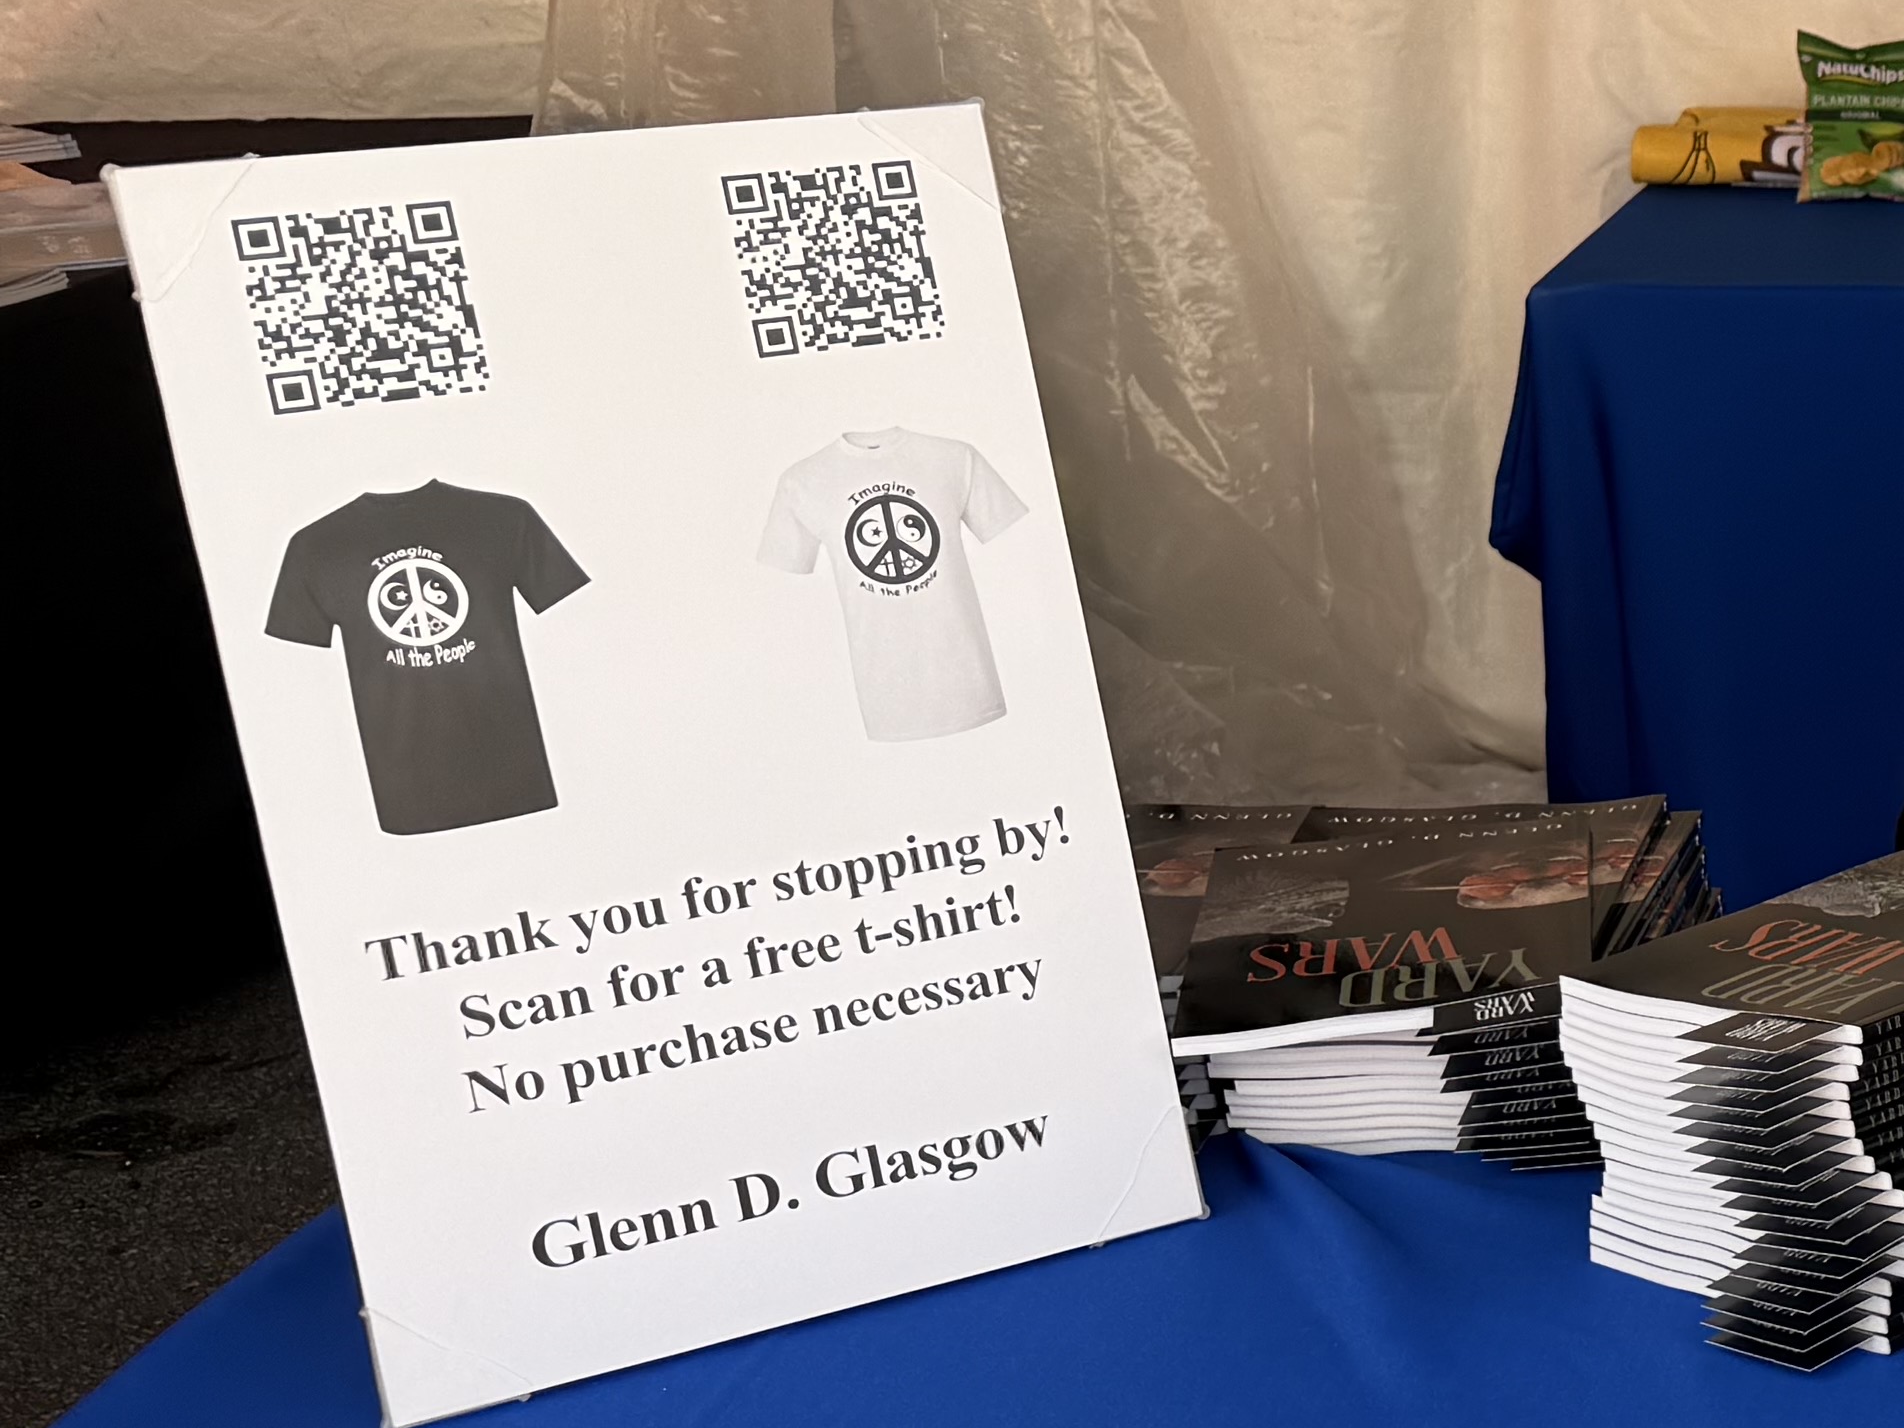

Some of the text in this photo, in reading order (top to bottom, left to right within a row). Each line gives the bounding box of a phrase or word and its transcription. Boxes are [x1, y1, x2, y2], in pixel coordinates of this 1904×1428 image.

[848, 481, 916, 506] Imagine
[371, 546, 443, 570] Imagine
[859, 569, 938, 597] All the People
[386, 638, 476, 668] All the People
[364, 805, 1069, 982] Thank you for stopping by!
[459, 883, 1021, 1041] Scan for a free t-shirt!
[1247, 926, 1464, 983] WARS
[1338, 948, 1541, 1009] YARD
[1700, 962, 1904, 1016] YARD
[463, 958, 1042, 1113] No purchase necessary
[532, 1115, 1049, 1268] Glenn D. Glasgow
